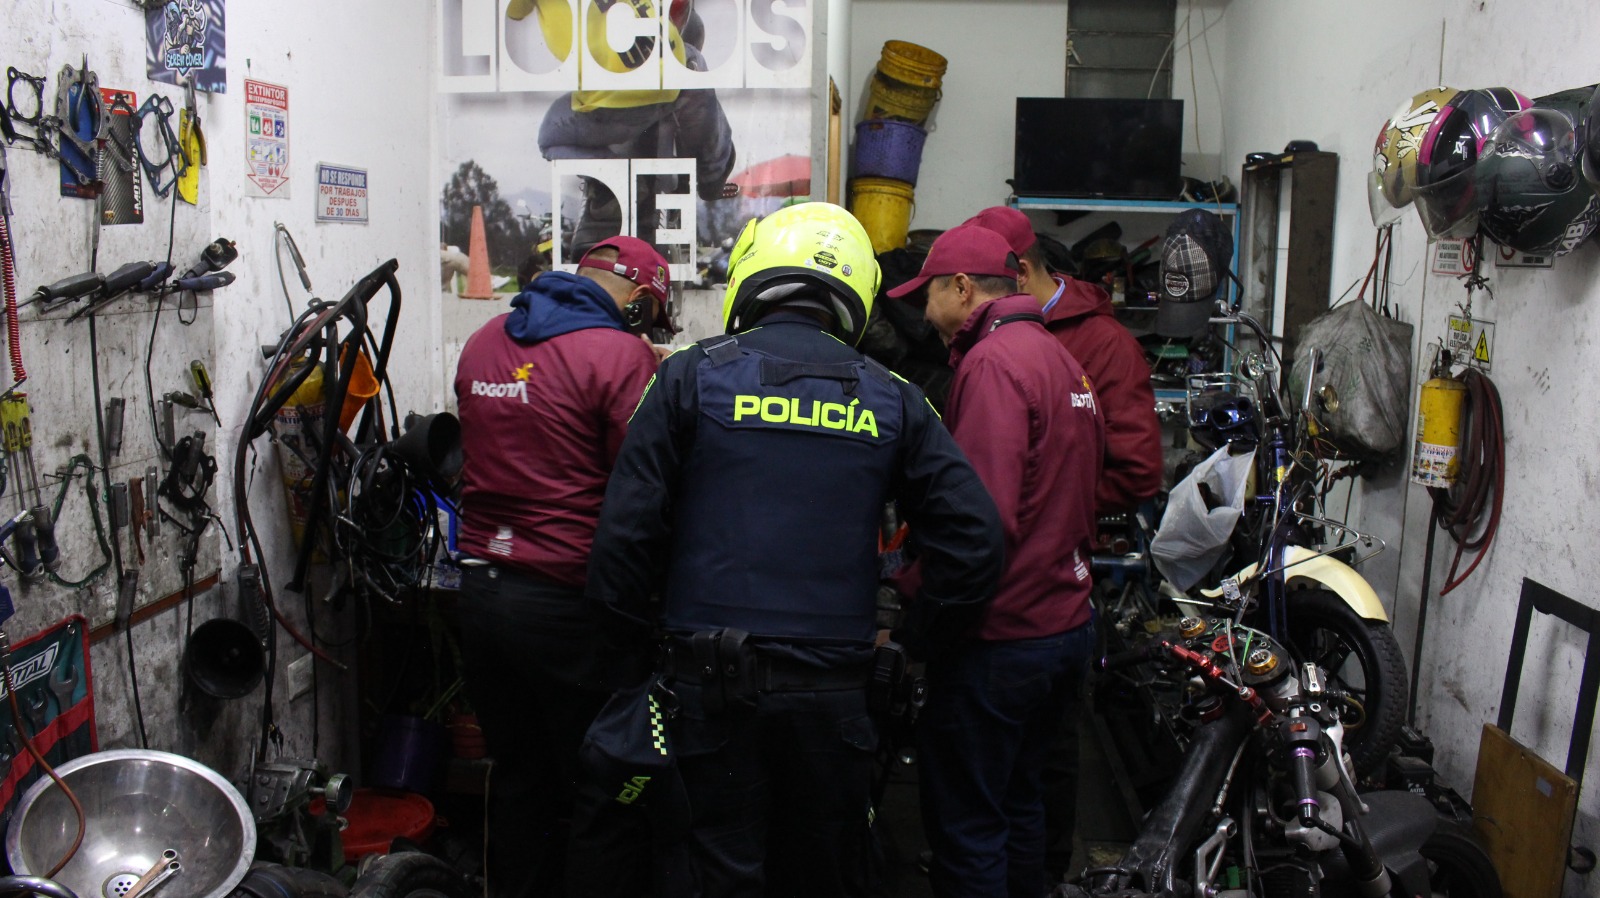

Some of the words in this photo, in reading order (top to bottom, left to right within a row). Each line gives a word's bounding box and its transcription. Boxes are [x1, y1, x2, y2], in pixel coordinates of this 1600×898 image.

[443, 0, 807, 76] LOCOS
[167, 53, 185, 68] SCREW
[185, 52, 203, 67] COVER
[248, 83, 286, 101] EXTINTOR
[321, 169, 330, 184] NO
[330, 170, 337, 185] SE
[337, 171, 365, 187] RESPONDE
[320, 185, 333, 195] POR
[335, 187, 366, 198] TRABAJOS
[329, 197, 357, 207] DESPUES
[326, 207, 335, 216] DE
[336, 208, 343, 217] 30
[560, 173, 691, 265] DE
[733, 395, 879, 438] POLICÍA
